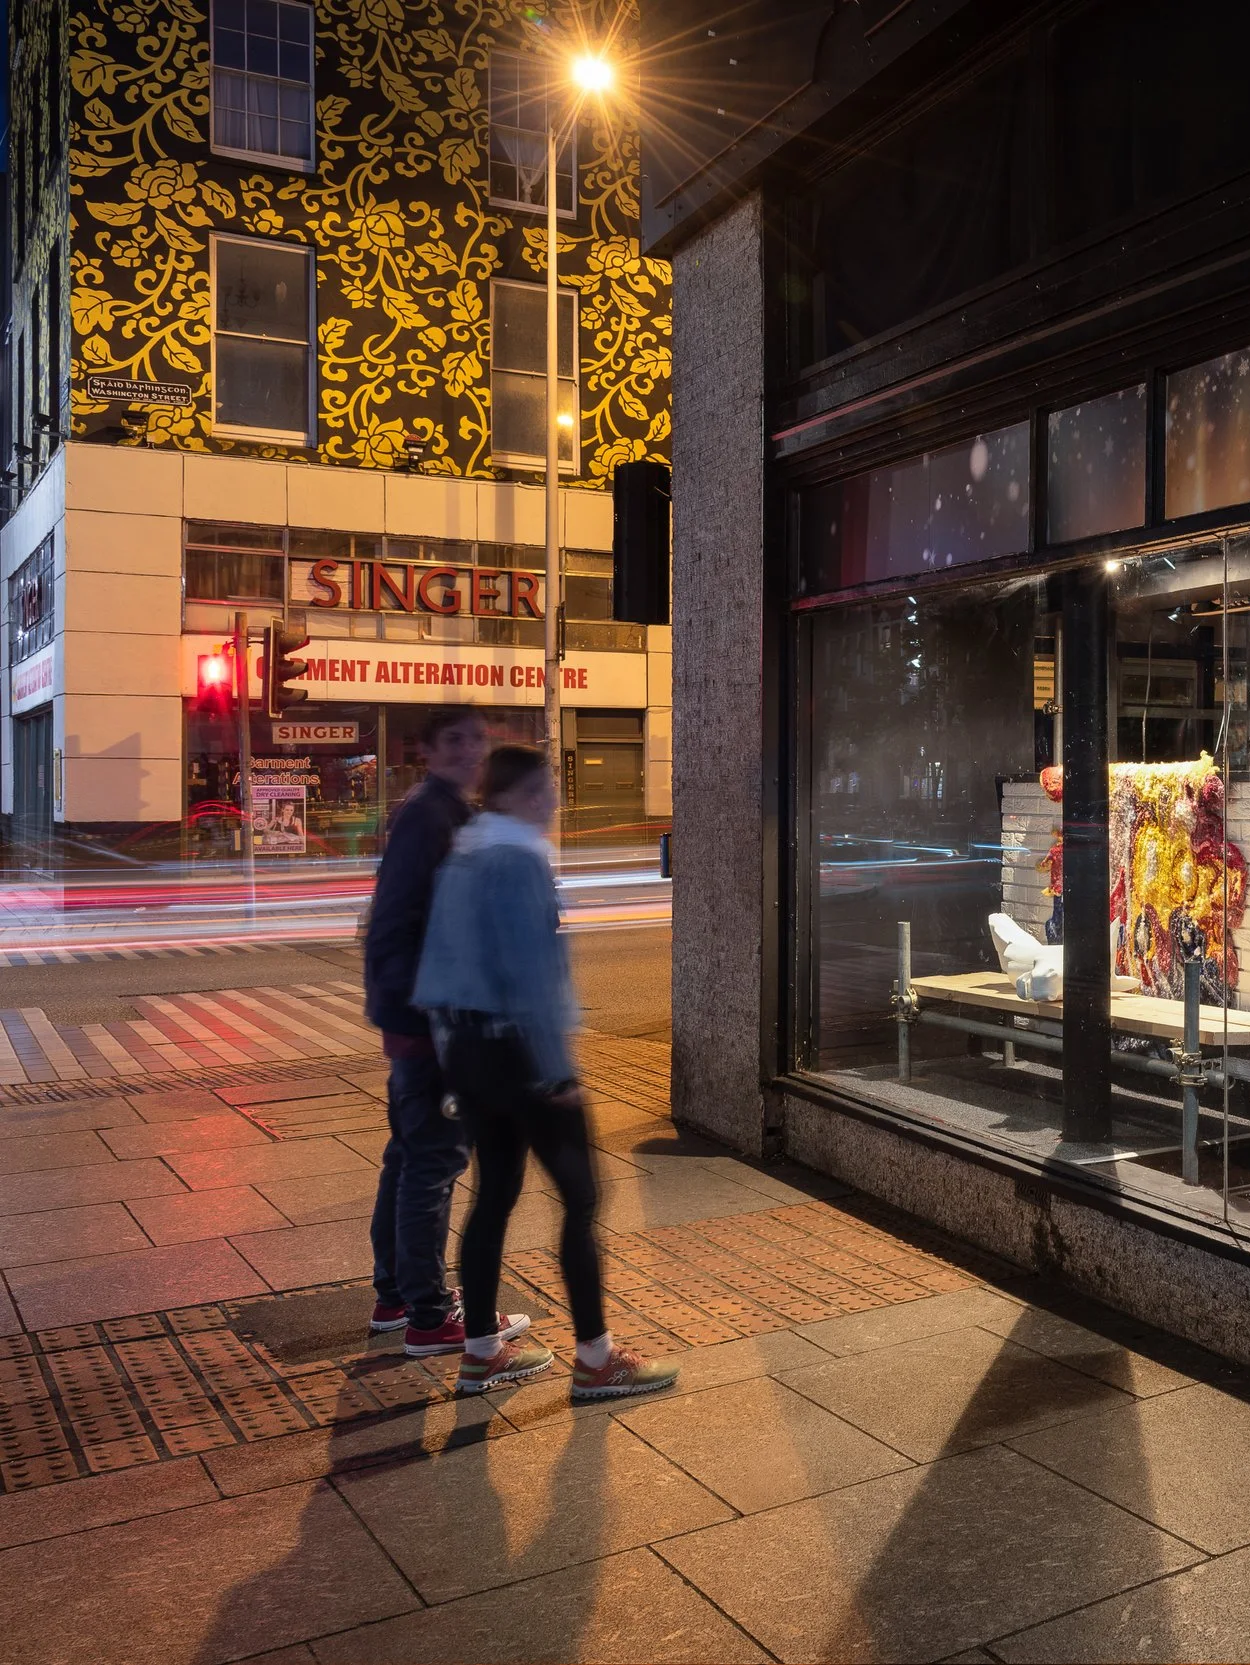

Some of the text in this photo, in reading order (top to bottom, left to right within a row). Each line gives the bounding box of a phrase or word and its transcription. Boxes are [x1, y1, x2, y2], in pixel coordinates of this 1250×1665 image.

[91, 387, 149, 399] WASHINGTON
[310, 559, 543, 618] SINGER
[375, 660, 505, 687] ALTERATION
[510, 665, 588, 689] CENRE
[278, 726, 354, 739] SINGER
